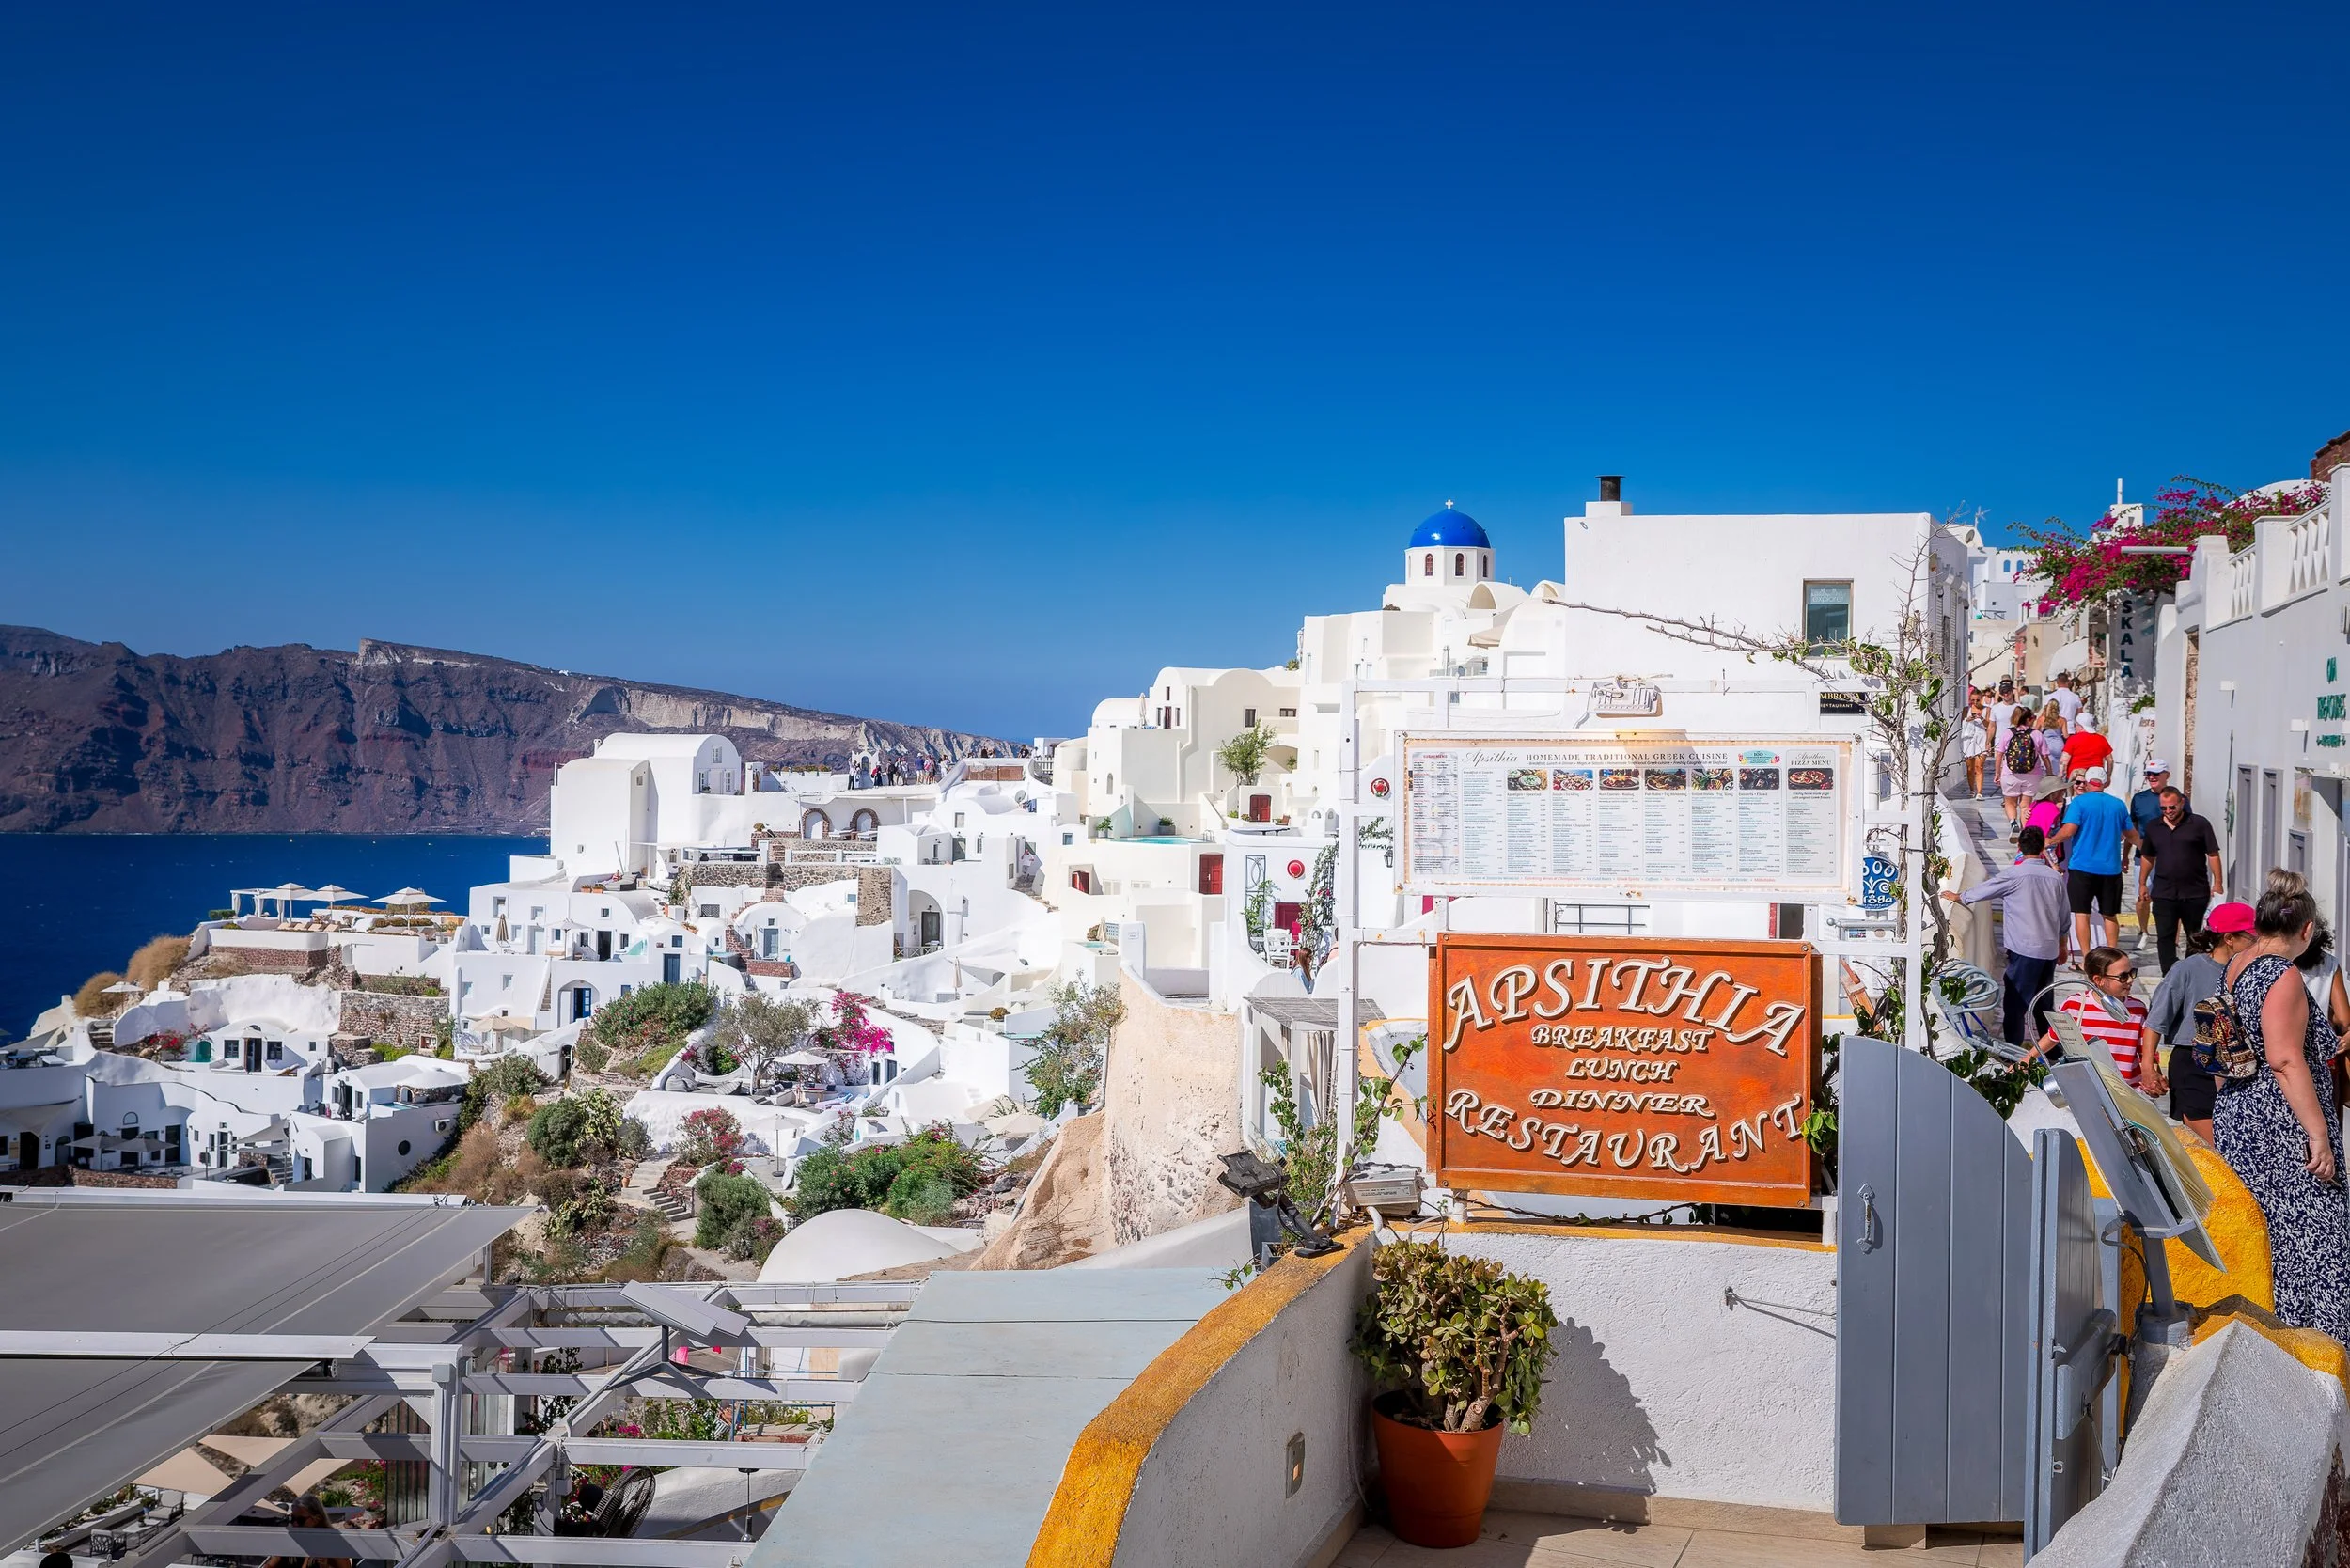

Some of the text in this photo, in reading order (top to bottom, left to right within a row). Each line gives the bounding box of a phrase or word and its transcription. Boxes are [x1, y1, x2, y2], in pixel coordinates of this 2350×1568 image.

[2120, 600, 2134, 678] SKALA
[1465, 748, 1519, 767] Apsithia
[1443, 956, 1806, 1058] APSITHIA
[1531, 1024, 1716, 1054] BREAKFAST
[1565, 1056, 1680, 1083] LUNCH
[1529, 1088, 1716, 1119] DINNER
[1444, 1088, 1804, 1174] RESTAURANT
